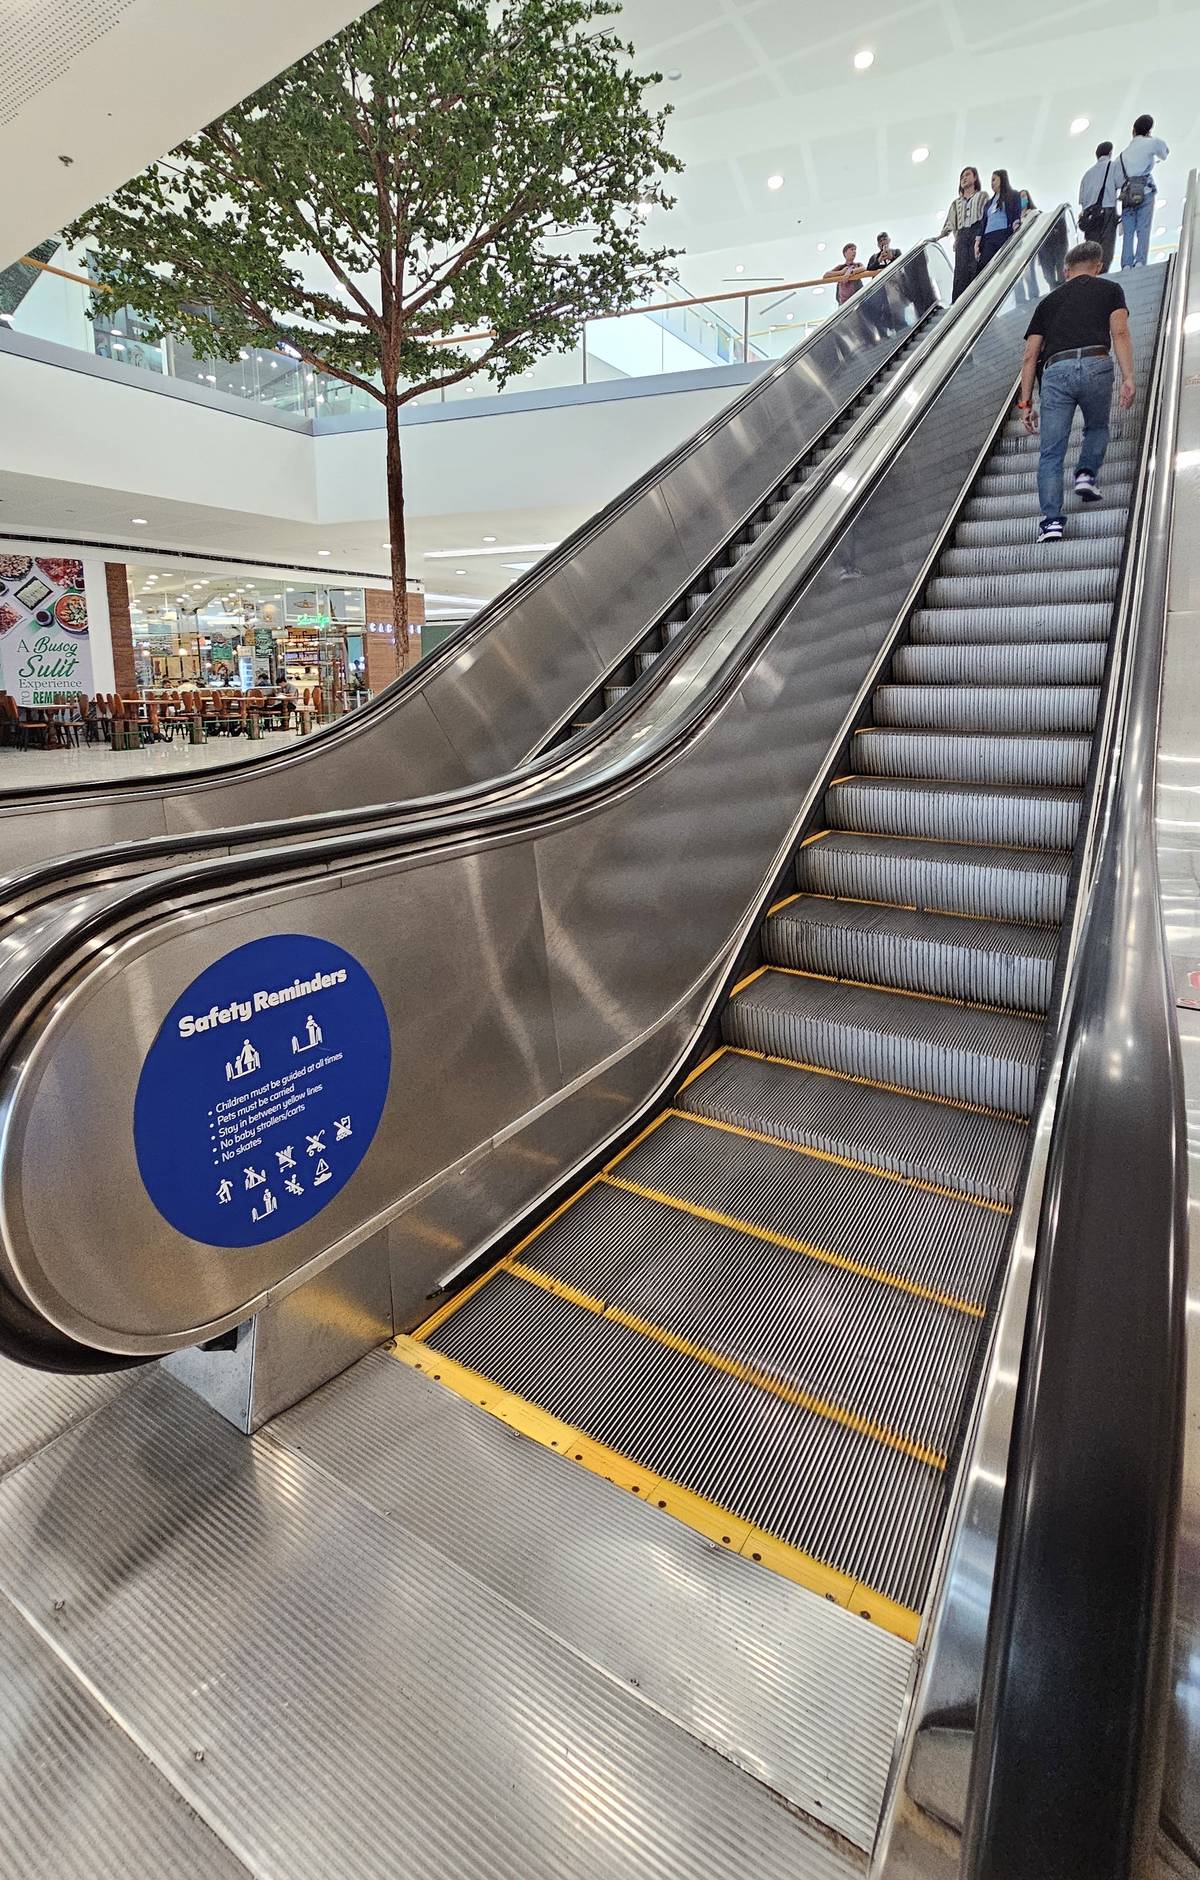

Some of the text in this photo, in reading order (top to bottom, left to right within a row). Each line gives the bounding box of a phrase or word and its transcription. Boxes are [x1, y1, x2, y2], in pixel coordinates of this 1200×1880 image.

[17, 636, 78, 657] A Busog
[18, 655, 80, 678] Sulit
[19, 679, 82, 690] Experience
[178, 968, 348, 1038] Safety Reminders
[215, 1052, 344, 1114] Children must be guided at all times
[217, 1083, 295, 1125] Pets must be carried
[218, 1083, 323, 1138] Stay in between yellow lines
[220, 1103, 306, 1150] No baby strollers/carts
[221, 1136, 262, 1163] No skates
